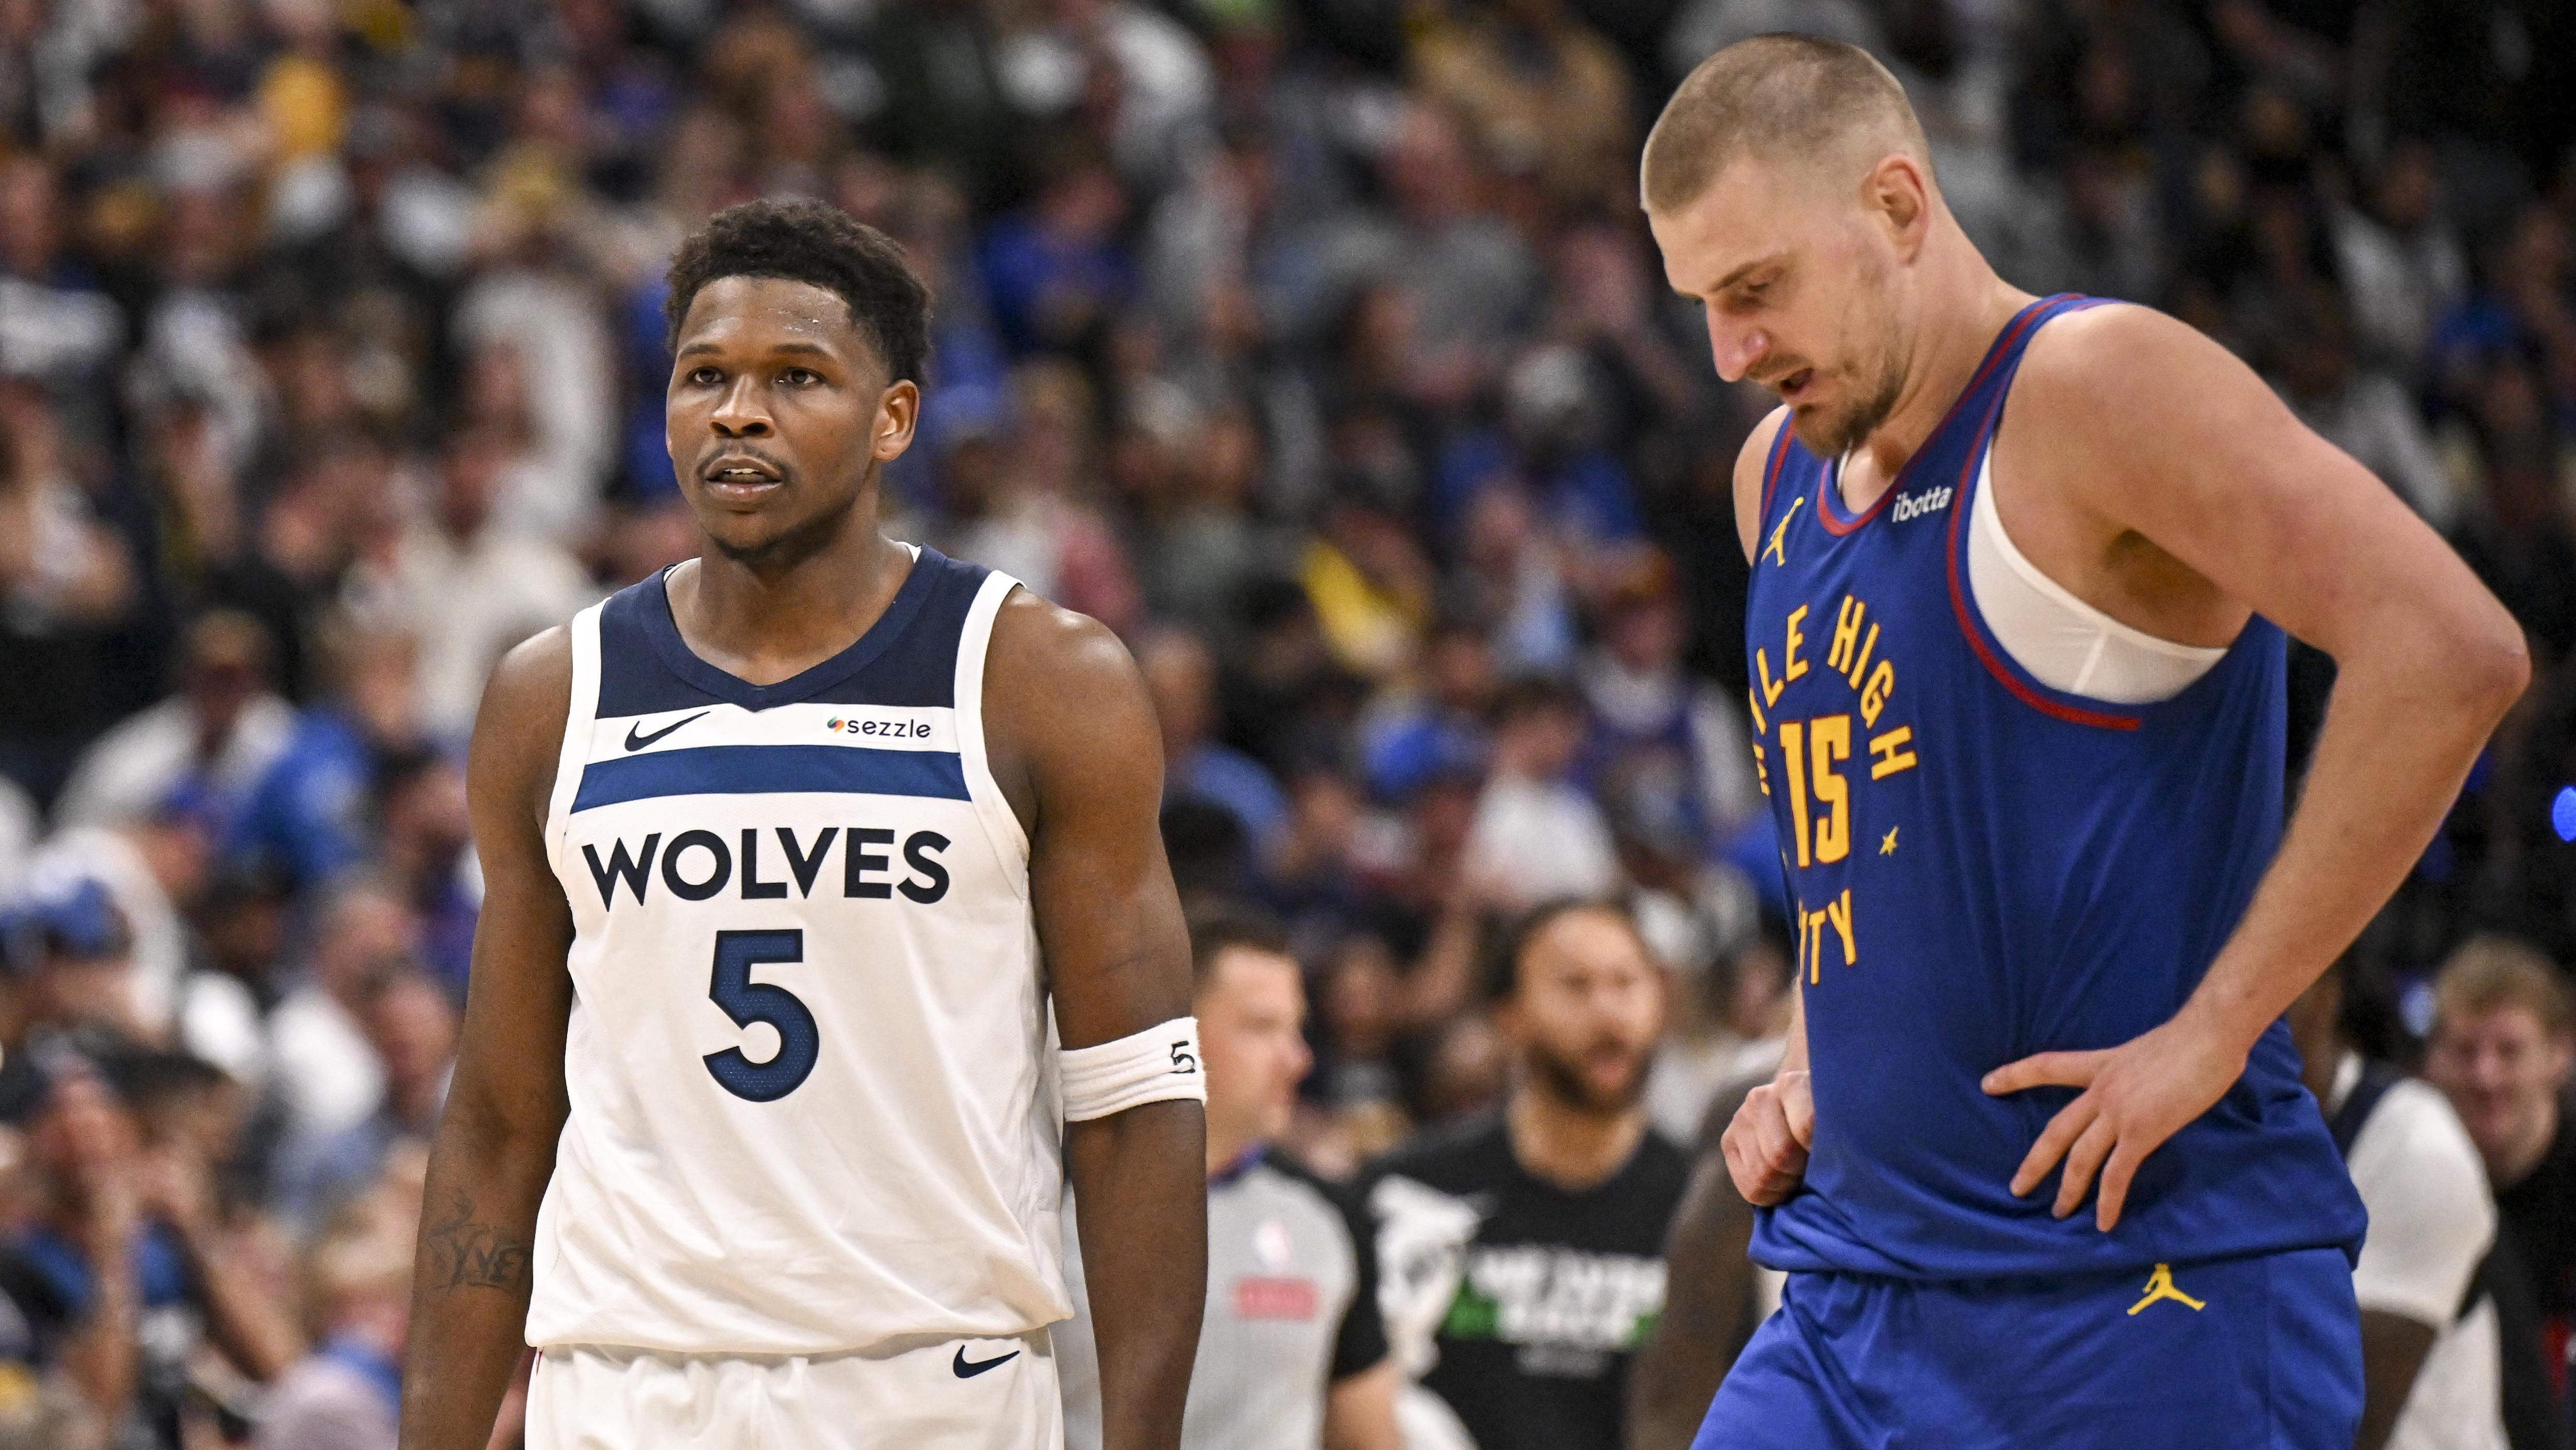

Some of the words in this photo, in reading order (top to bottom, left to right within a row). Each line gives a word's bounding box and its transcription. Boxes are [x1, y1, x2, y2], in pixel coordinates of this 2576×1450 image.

[1892, 485, 1953, 523] ibotta
[848, 719, 931, 738] sezzle
[1827, 594, 1918, 781] HIGH
[1779, 714, 1851, 869] 15
[582, 827, 952, 912] WOLVES
[1798, 888, 1857, 985] ITY
[703, 929, 820, 1102] 5
[1170, 1040, 1195, 1073] 5
